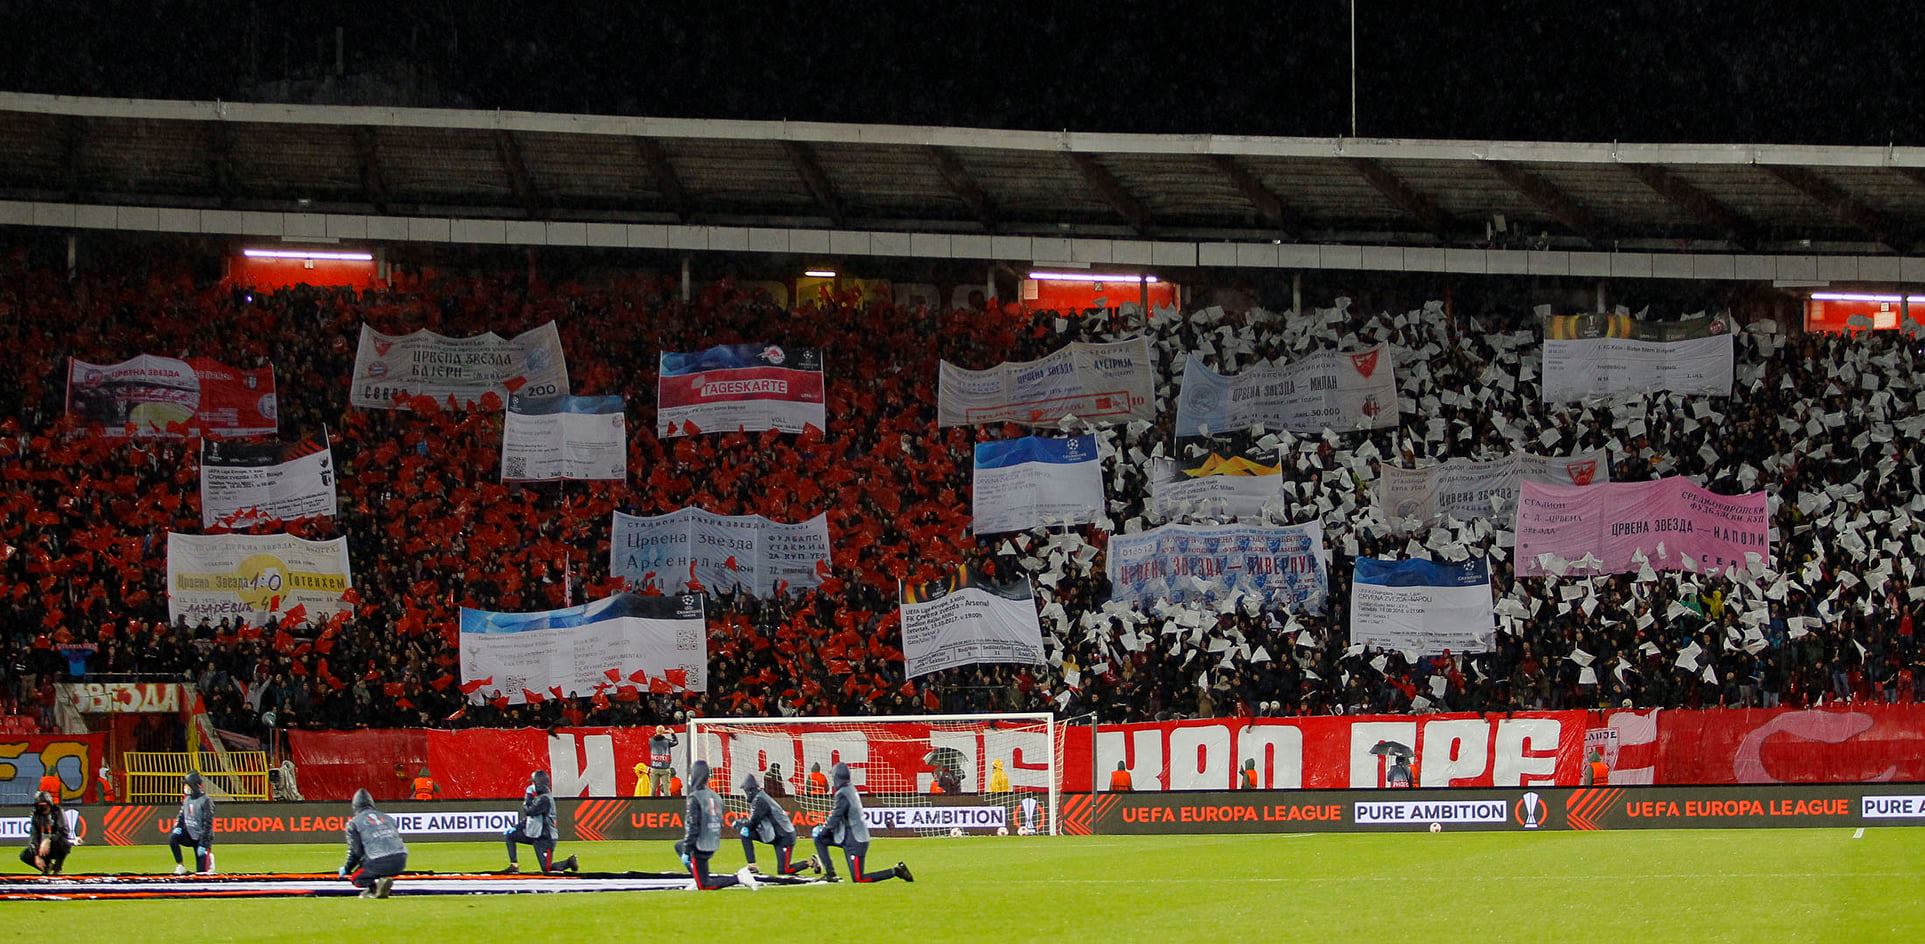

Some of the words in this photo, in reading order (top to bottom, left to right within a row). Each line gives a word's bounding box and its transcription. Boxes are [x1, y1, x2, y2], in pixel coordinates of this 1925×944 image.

[528, 384, 556, 397] 200
[704, 380, 786, 395] TAGESKARTE
[1612, 522, 1650, 536] ЦРВЕНА
[1654, 518, 1694, 533] ЗВЕЗДА
[1713, 528, 1765, 546] НАПОЛИ
[628, 532, 688, 550] Црвена
[288, 573, 346, 589] Тотенхем
[1122, 807, 1176, 823] UEFA
[1180, 806, 1258, 822] EUROPA
[1263, 805, 1341, 820] LEAGUE
[1356, 806, 1405, 820] PURE
[1410, 804, 1504, 819] AMBITION
[1626, 801, 1680, 817] UEFA
[1686, 800, 1765, 816] EUROPA
[1770, 799, 1849, 816] LEAGUE
[1863, 800, 1912, 814] PURE
[212, 818, 286, 832] EUROPA
[291, 817, 352, 833] LEAGU
[428, 814, 516, 830] AMBITION
[632, 813, 682, 828] UEFA
[912, 809, 1003, 825] AMBITION
